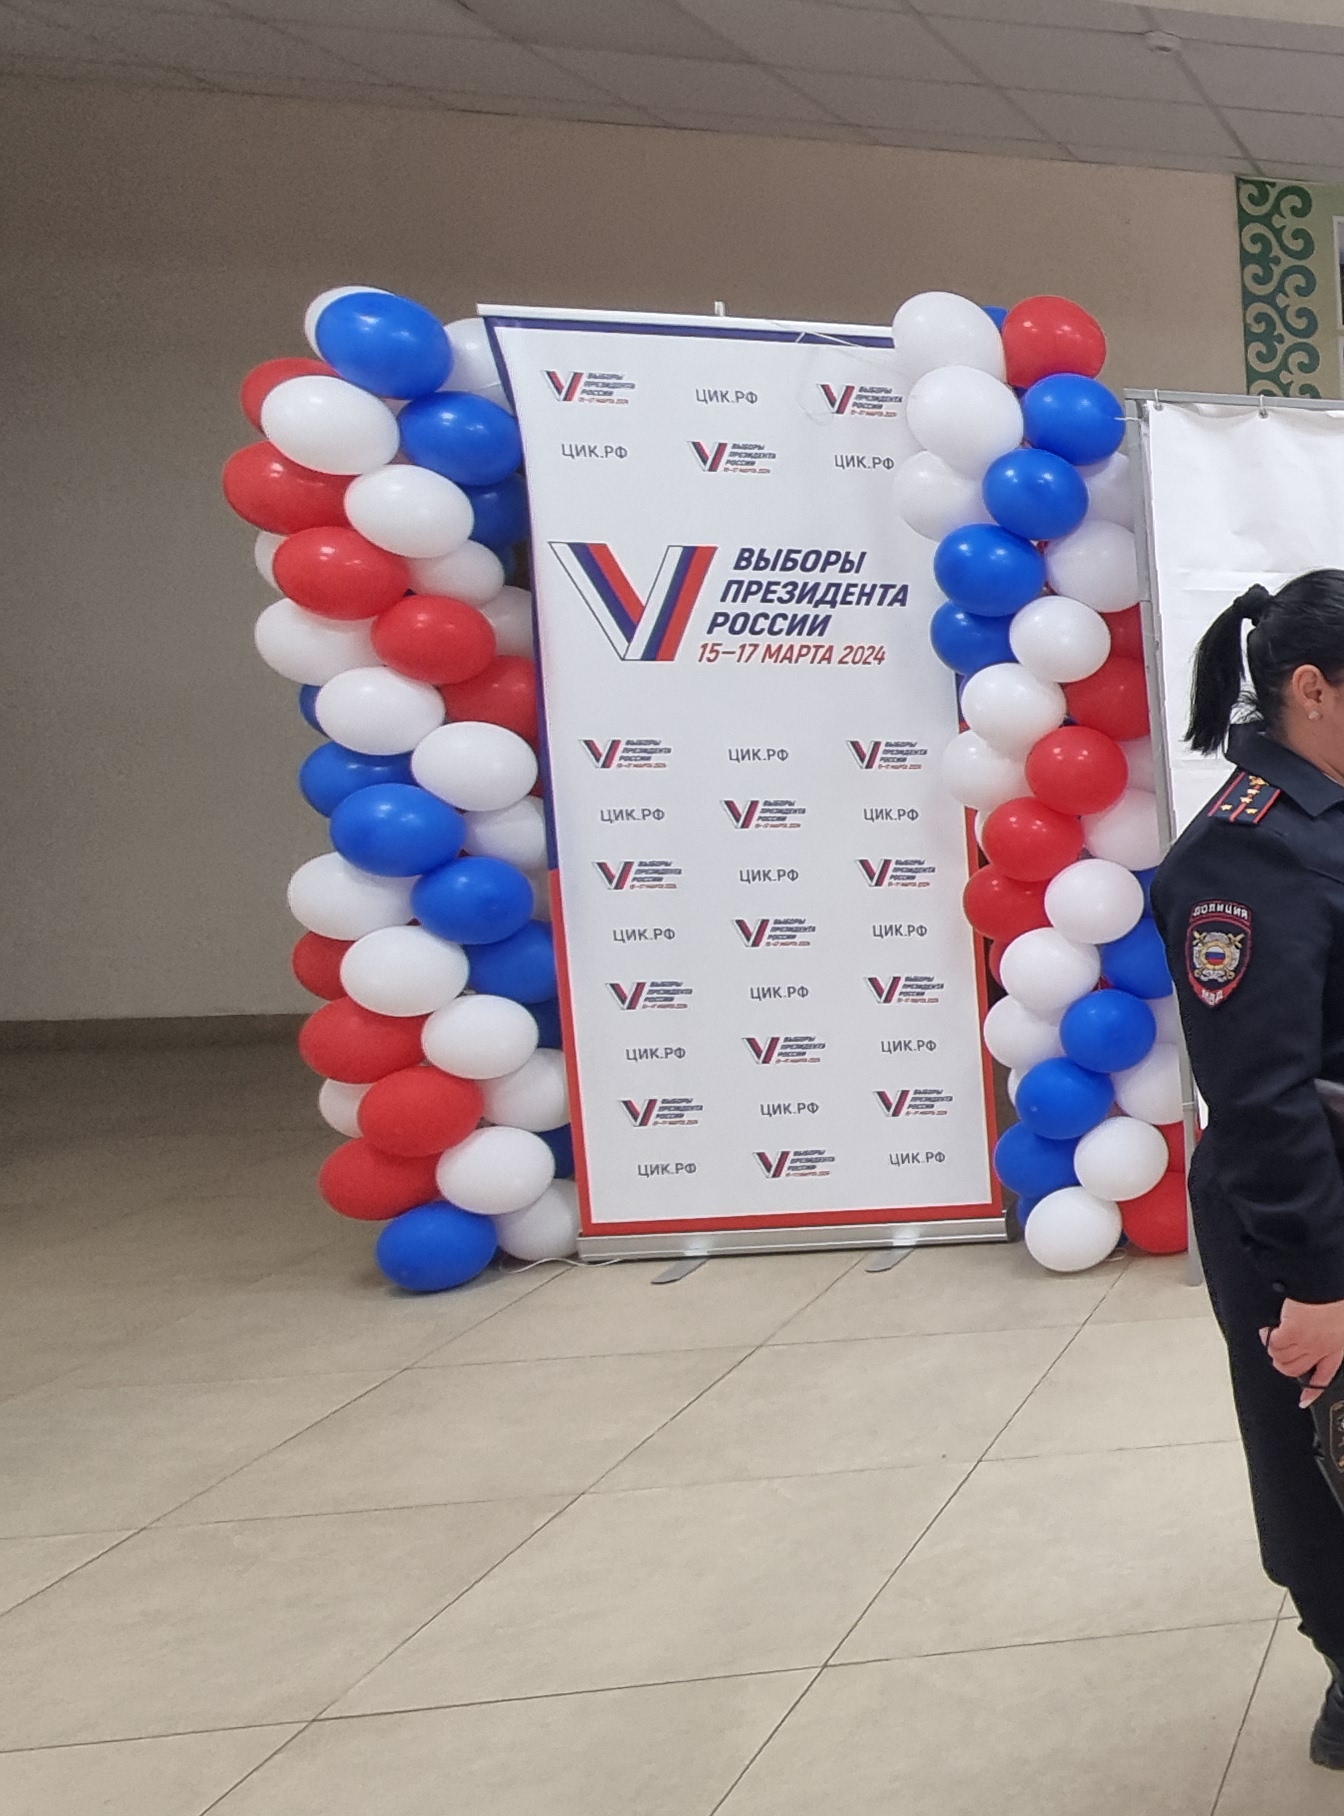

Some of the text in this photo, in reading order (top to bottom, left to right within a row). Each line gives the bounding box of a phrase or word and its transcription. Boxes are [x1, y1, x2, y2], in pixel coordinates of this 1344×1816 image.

[695, 388, 758, 405] ЦИК.РФ
[561, 443, 629, 460] ЦИК.РФ
[834, 454, 895, 471] ЦИК.РФ
[733, 547, 867, 574] ВЫБОРЫ
[719, 579, 910, 609] ПРЕЗИДЕНТА
[706, 611, 833, 637] РОССИИ
[760, 643, 836, 665] МАРТА
[837, 645, 886, 666] 2024
[728, 747, 789, 763] ЦИК.РФ
[600, 807, 665, 823] ЦИК.РФ
[863, 807, 919, 823] ЦИК.РФ
[739, 867, 799, 884] ЦИК.РФ
[1193, 903, 1249, 919] ПОЛИЦИЯ
[613, 927, 676, 944] ЦИК.РФ
[872, 923, 928, 940] ЦИК.РФ
[750, 985, 810, 1001] ЦИК.РФ
[626, 1046, 686, 1062] ЦИК.РФ
[881, 1038, 937, 1055] ЦИК.РФ
[760, 1102, 820, 1118] ЦИК.РФ
[889, 1150, 946, 1167] ЦИК.РФ
[637, 1162, 697, 1178] ЦИК.РФ
